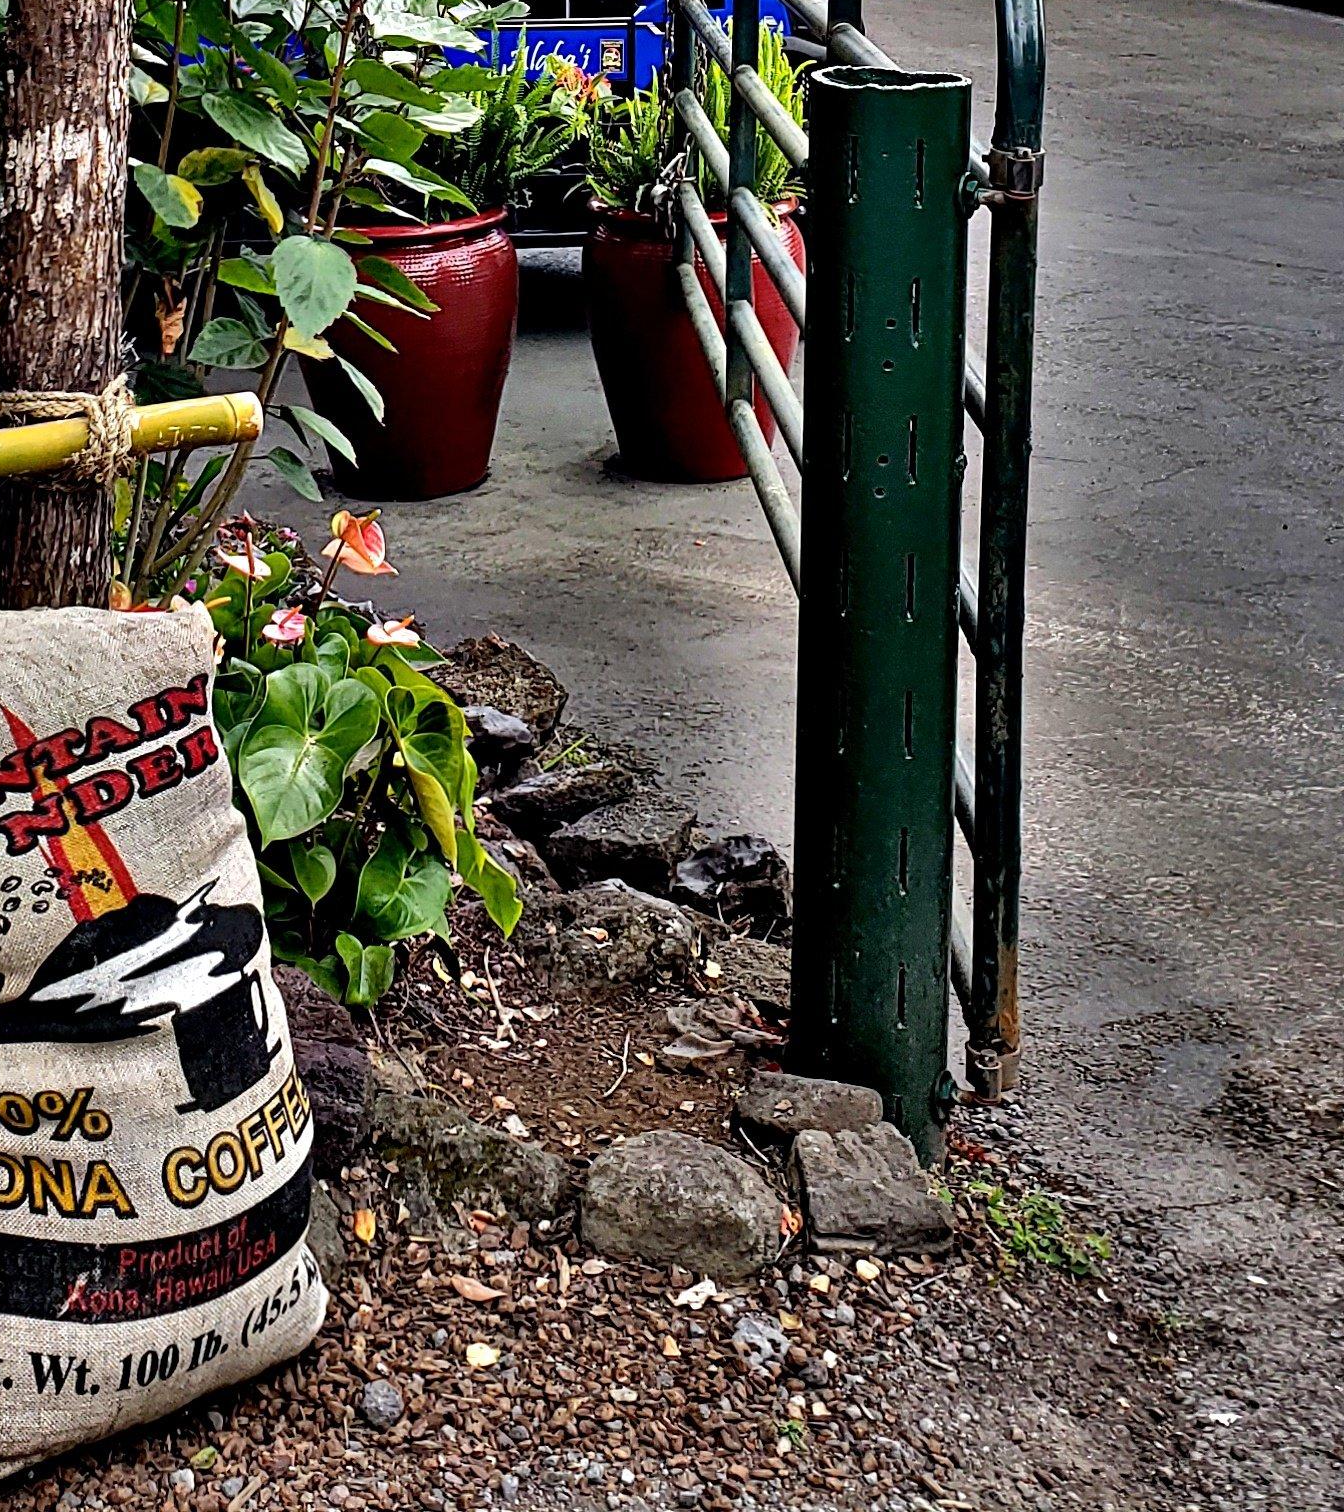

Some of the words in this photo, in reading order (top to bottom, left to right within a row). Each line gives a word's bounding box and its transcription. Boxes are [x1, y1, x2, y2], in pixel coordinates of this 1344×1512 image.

[119, 1228, 221, 1277] Product
[227, 1215, 249, 1250] of
[237, 1230, 277, 1276] USA
[28, 1351, 101, 1396] Wt.
[116, 1343, 180, 1392] 100
